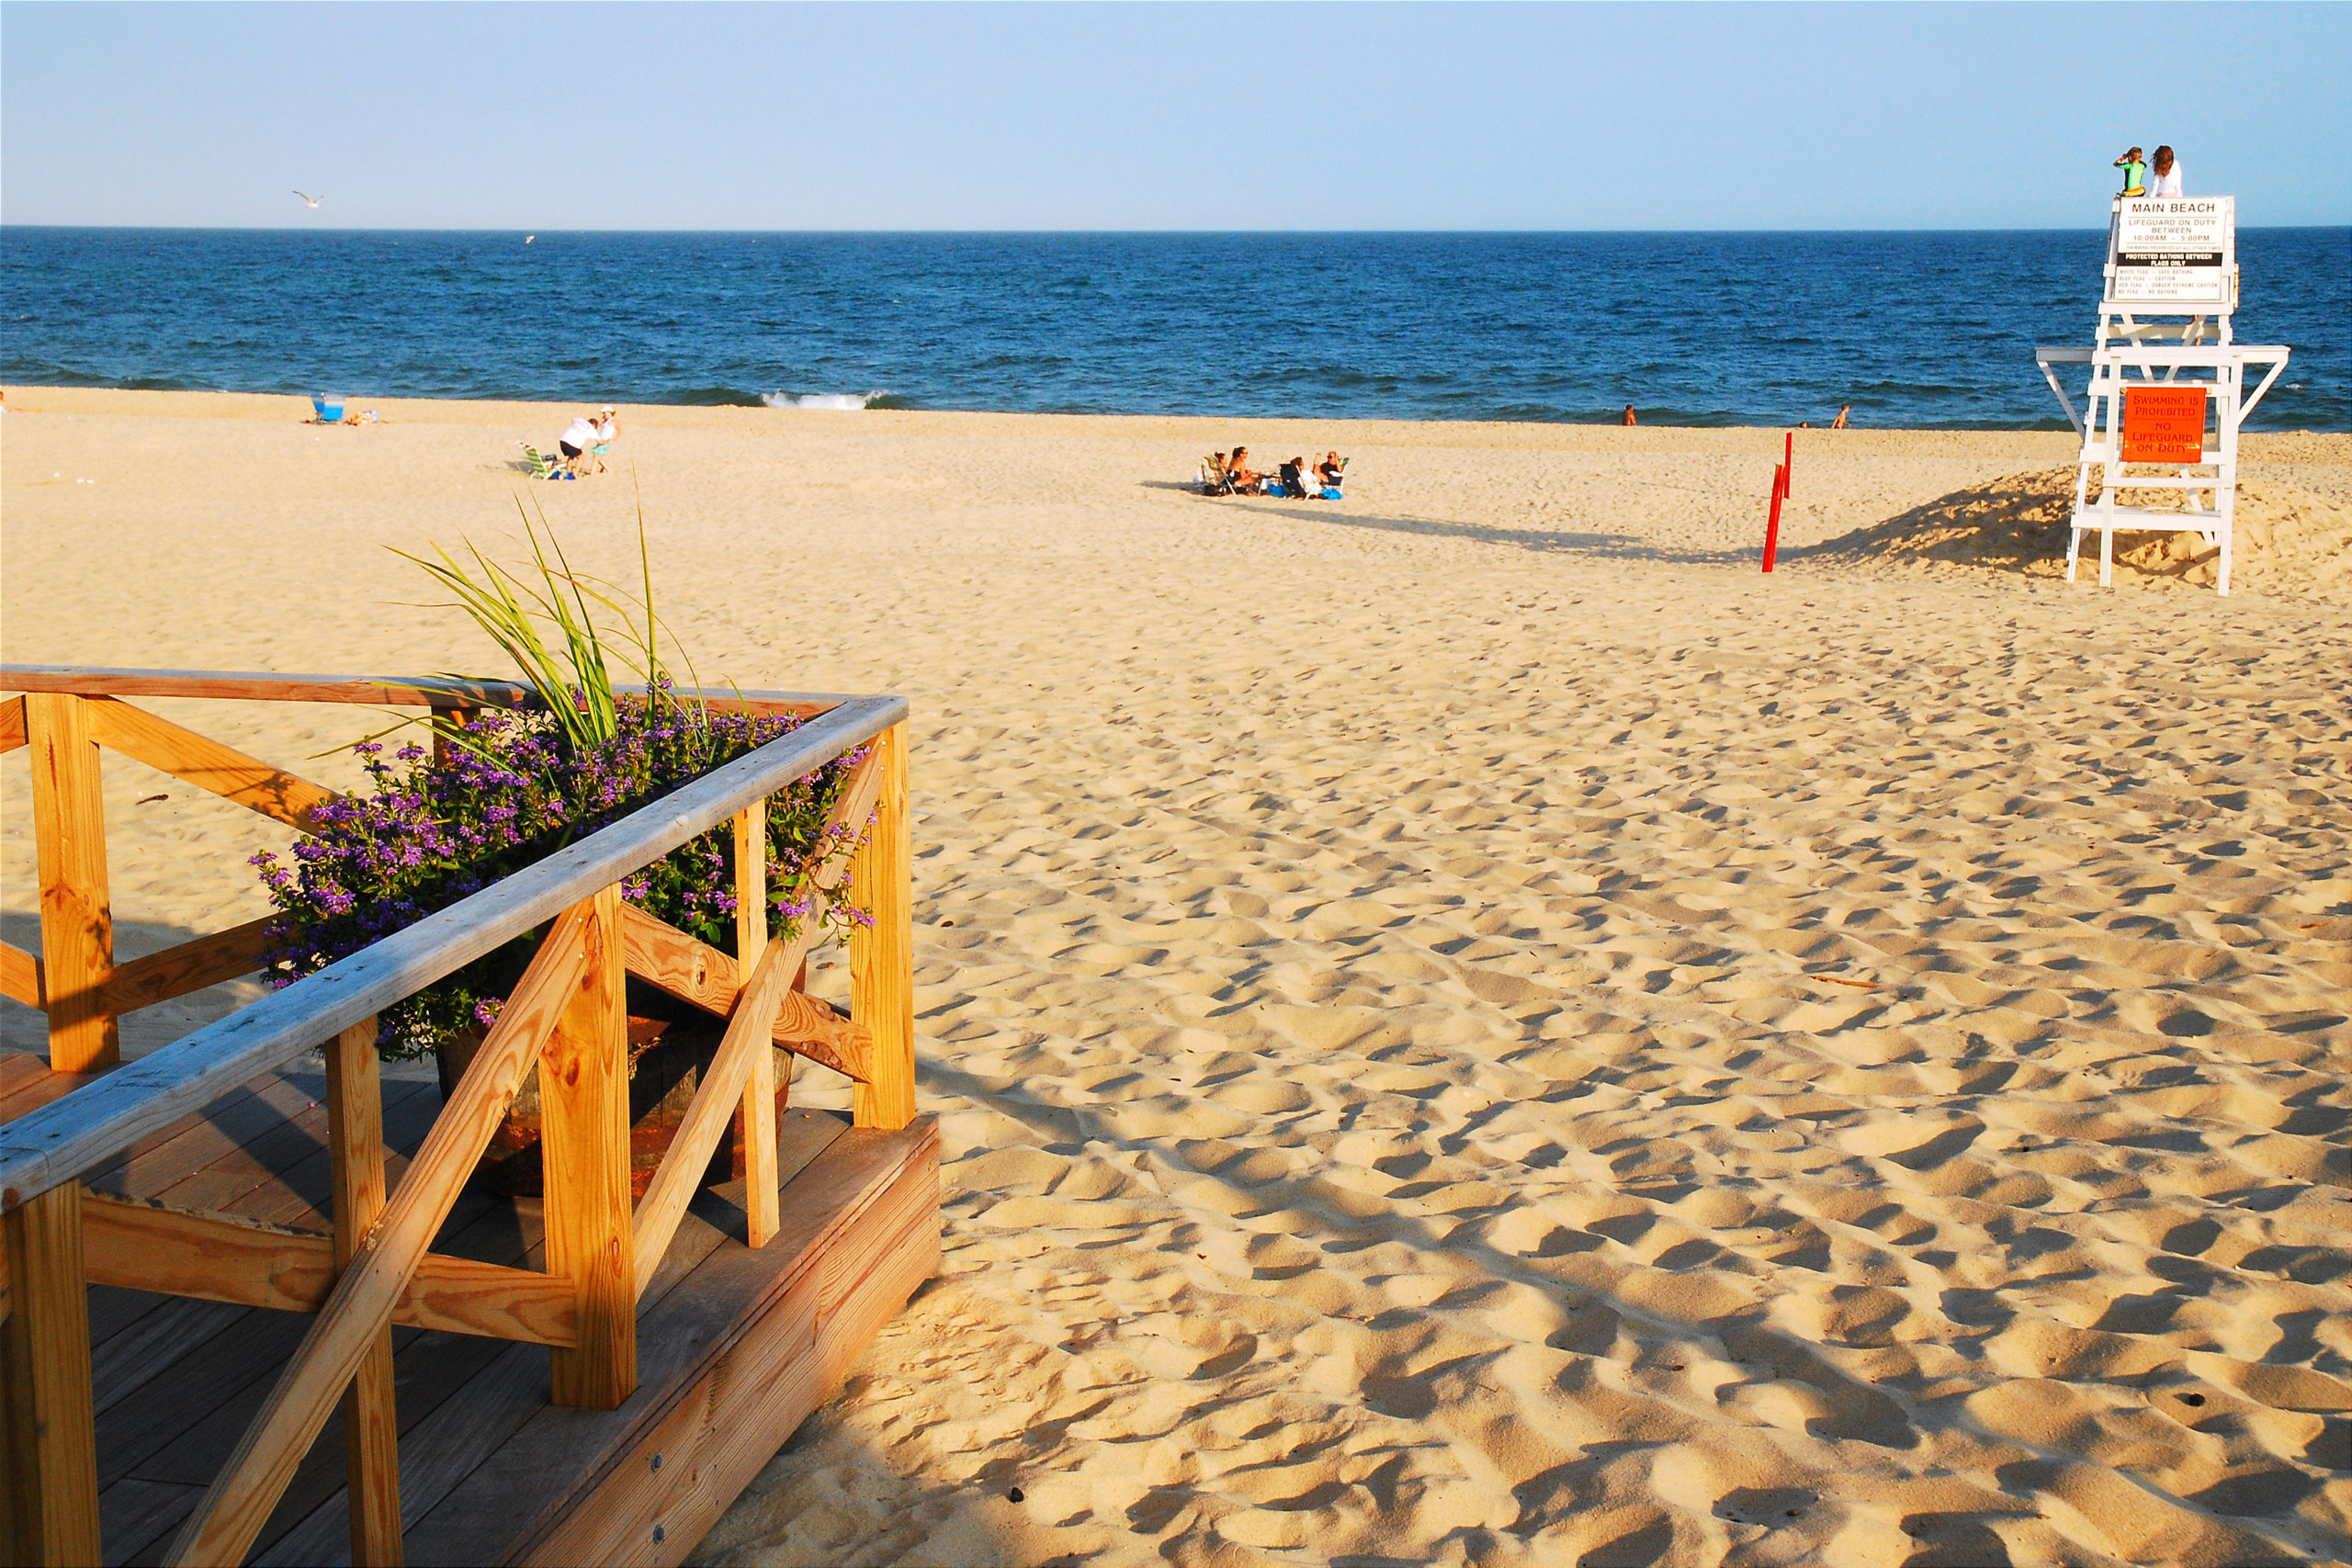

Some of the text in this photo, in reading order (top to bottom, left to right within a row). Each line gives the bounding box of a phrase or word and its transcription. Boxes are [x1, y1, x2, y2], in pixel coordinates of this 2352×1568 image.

[2132, 203, 2215, 212] MAIN BEACH
[2133, 395, 2184, 405] SWIMMING
[2135, 407, 2195, 416] PROHIBITED
[2133, 433, 2193, 442] LIFEGUARD
[2159, 444, 2185, 452] DUTY
